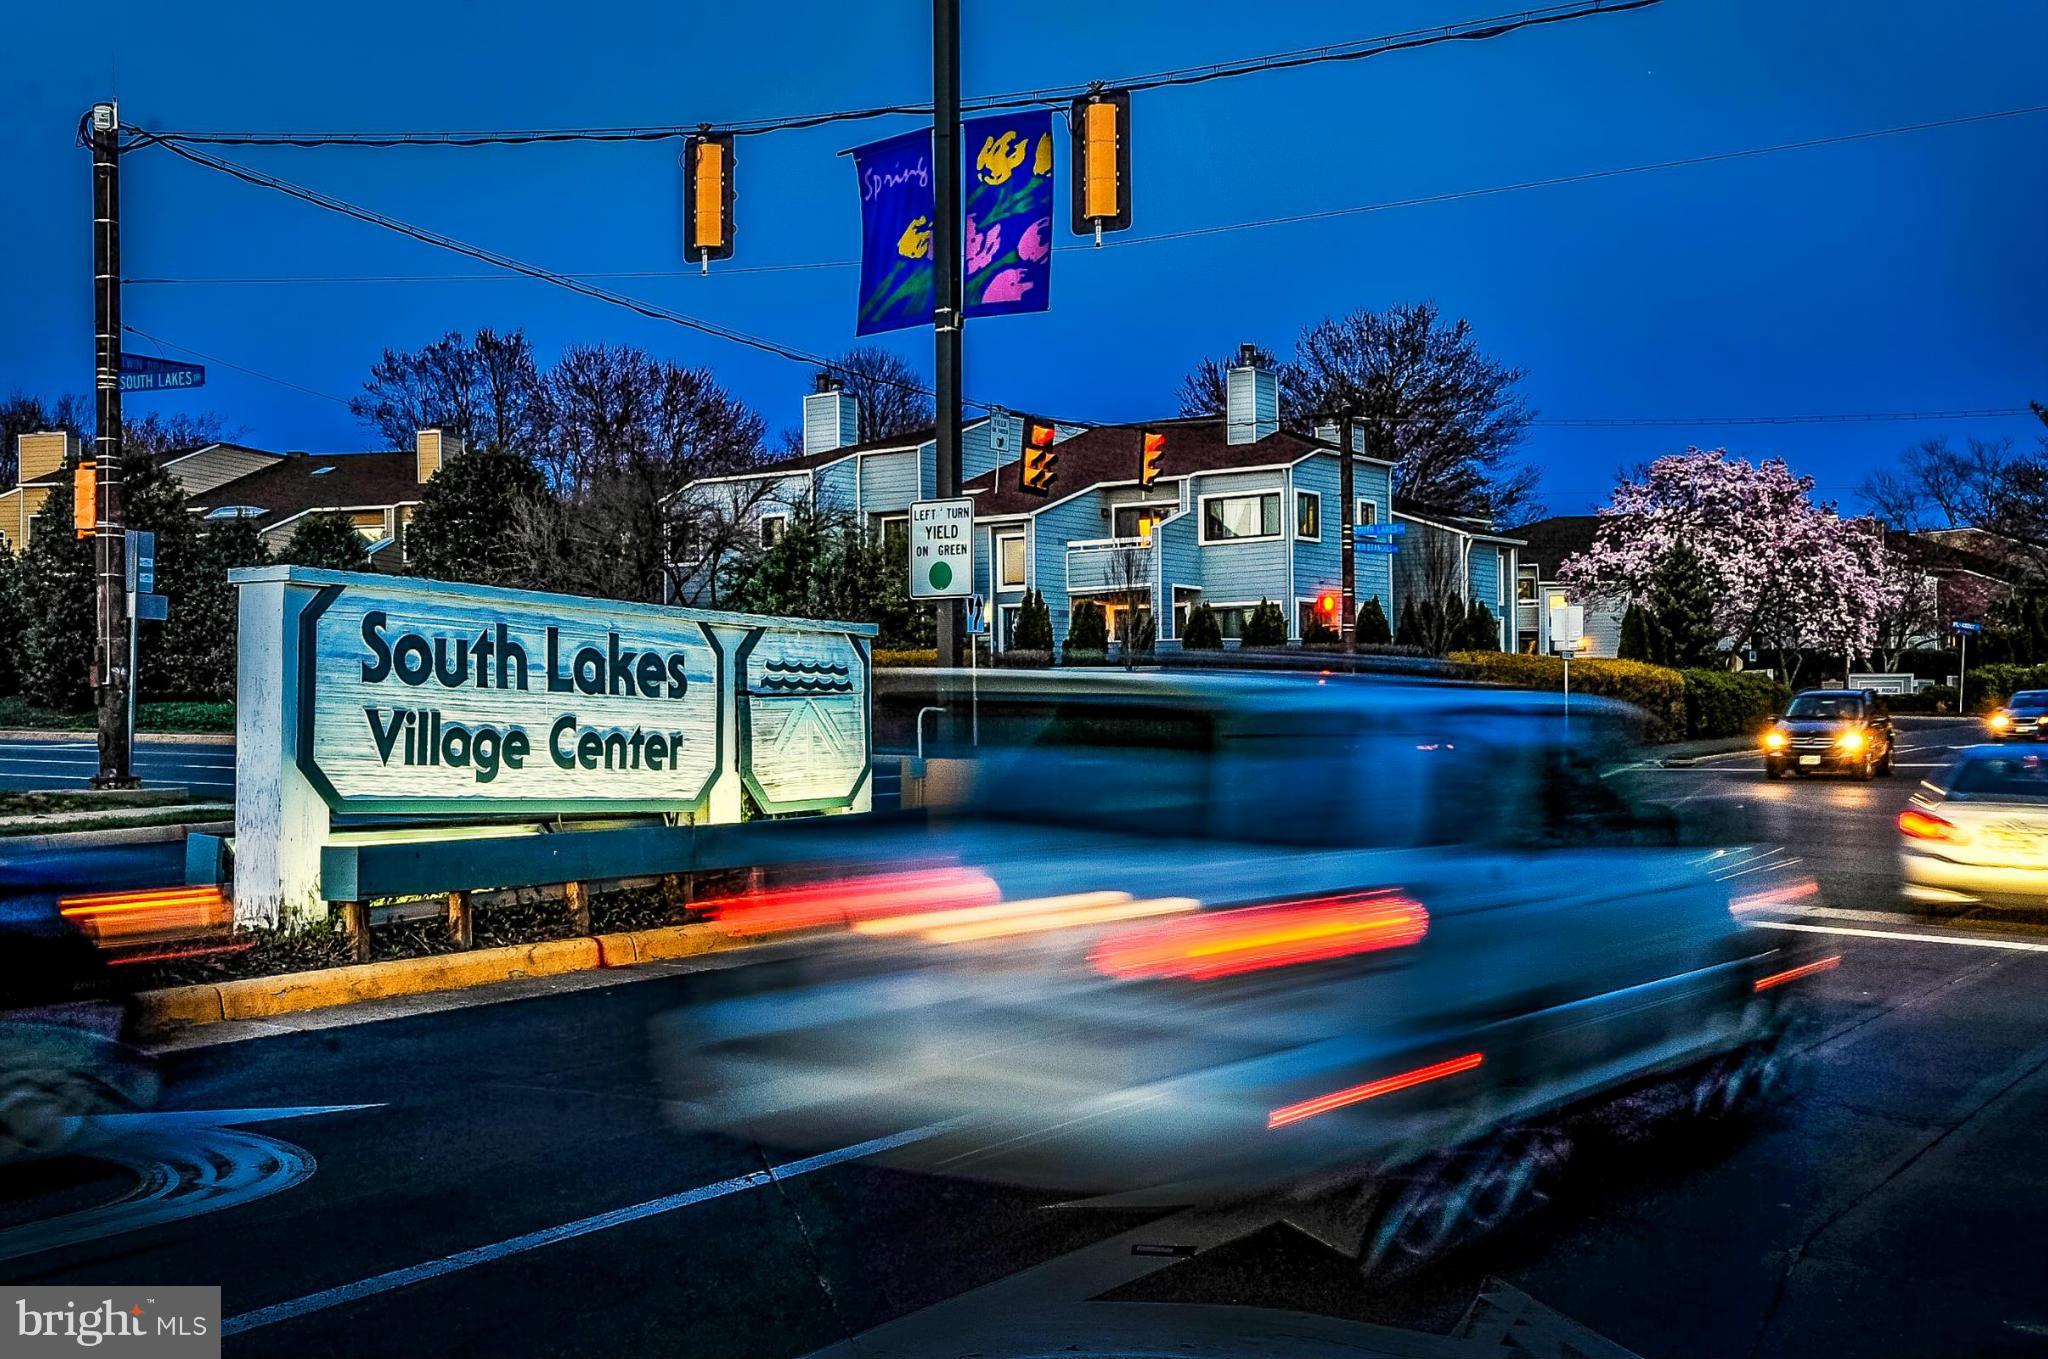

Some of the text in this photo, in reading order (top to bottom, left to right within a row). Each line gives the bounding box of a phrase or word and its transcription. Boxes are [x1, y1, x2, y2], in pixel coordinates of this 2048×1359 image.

[864, 157, 929, 202] Spring
[120, 374, 153, 390] SOUTH
[158, 371, 192, 388] LAKES
[914, 507, 970, 521] LEFT TURN
[925, 524, 958, 540] YIELD
[916, 543, 967, 557] ON GREEN
[360, 610, 689, 700] South Lakes
[363, 707, 684, 783] Village Center
